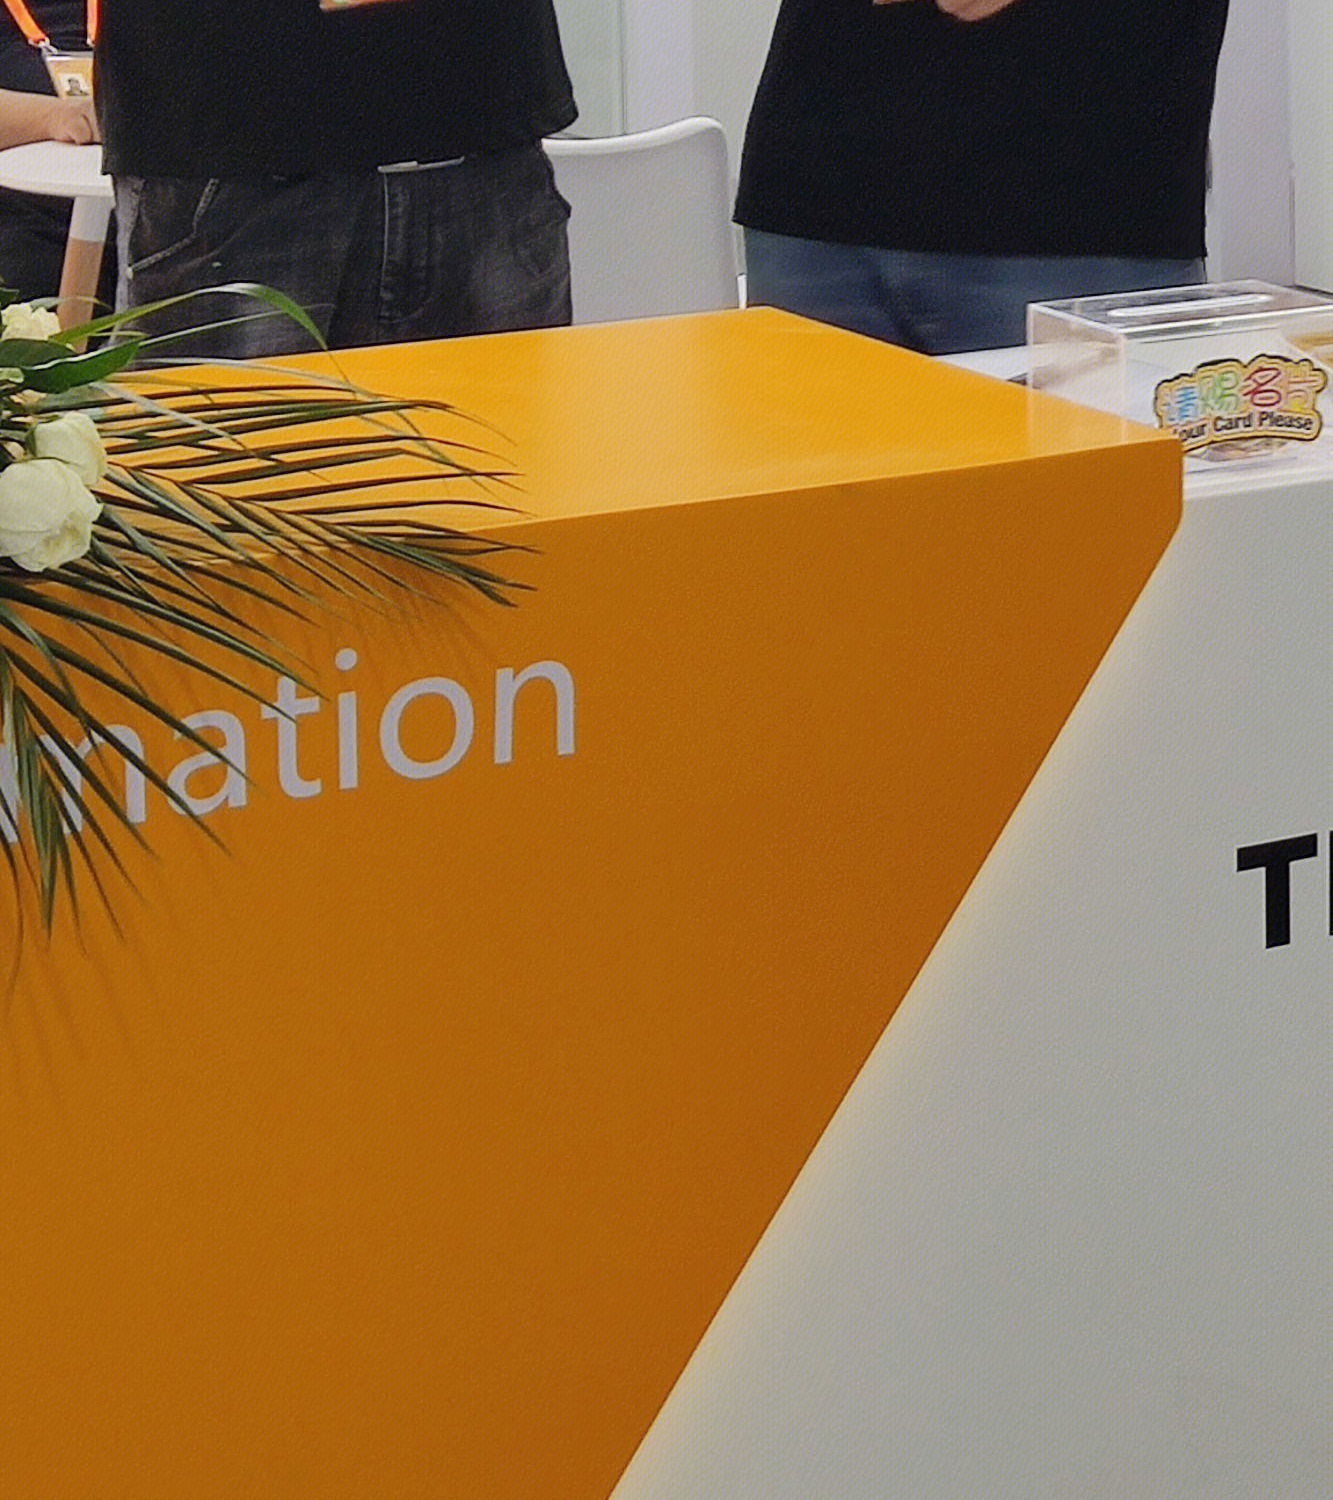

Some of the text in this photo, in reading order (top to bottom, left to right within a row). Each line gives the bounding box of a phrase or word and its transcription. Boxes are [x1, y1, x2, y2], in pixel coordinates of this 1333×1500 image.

[1173, 409, 1314, 442] our Card Please
